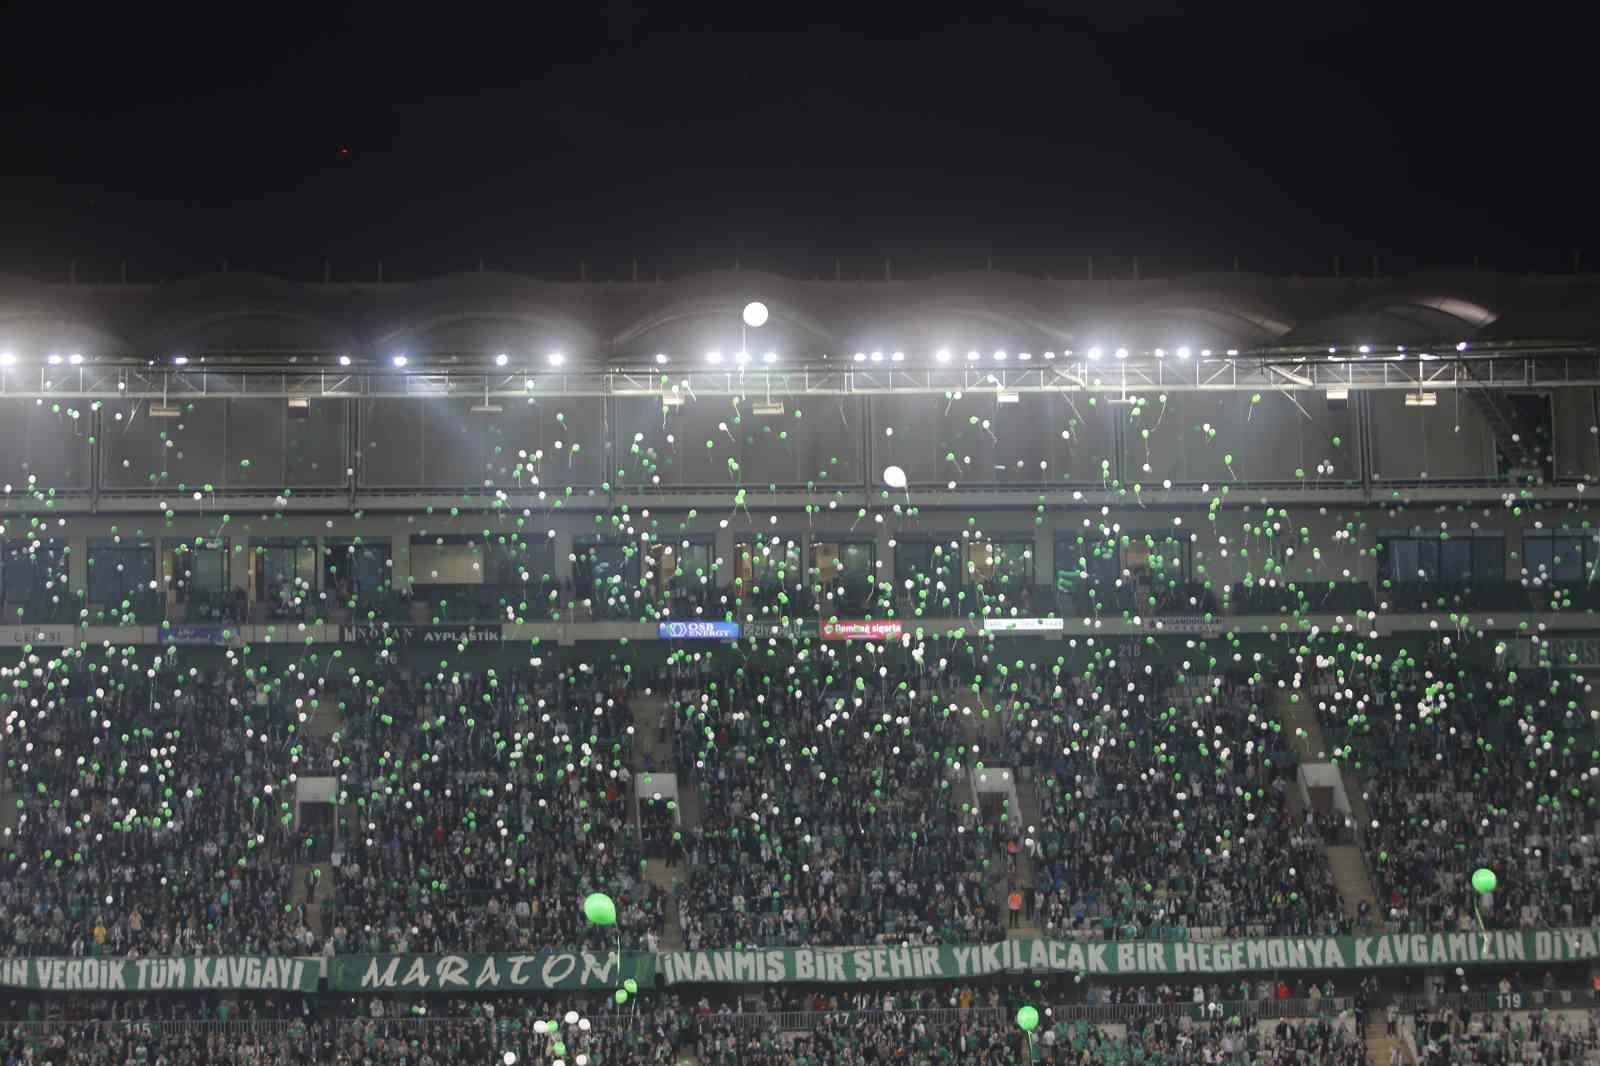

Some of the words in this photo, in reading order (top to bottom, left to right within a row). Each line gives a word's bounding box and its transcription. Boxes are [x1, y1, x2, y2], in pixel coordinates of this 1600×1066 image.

[361, 951, 618, 988] MARATON
[952, 939, 1108, 975] YIKILACAK
[1174, 938, 1346, 972] HEGEMONYA
[1354, 931, 1526, 968] KAVGAMIZIN
[1535, 929, 1600, 961] DİYA
[135, 957, 186, 990] TÜM
[192, 956, 304, 991] KAVGAYI
[1496, 993, 1521, 1009] 119
